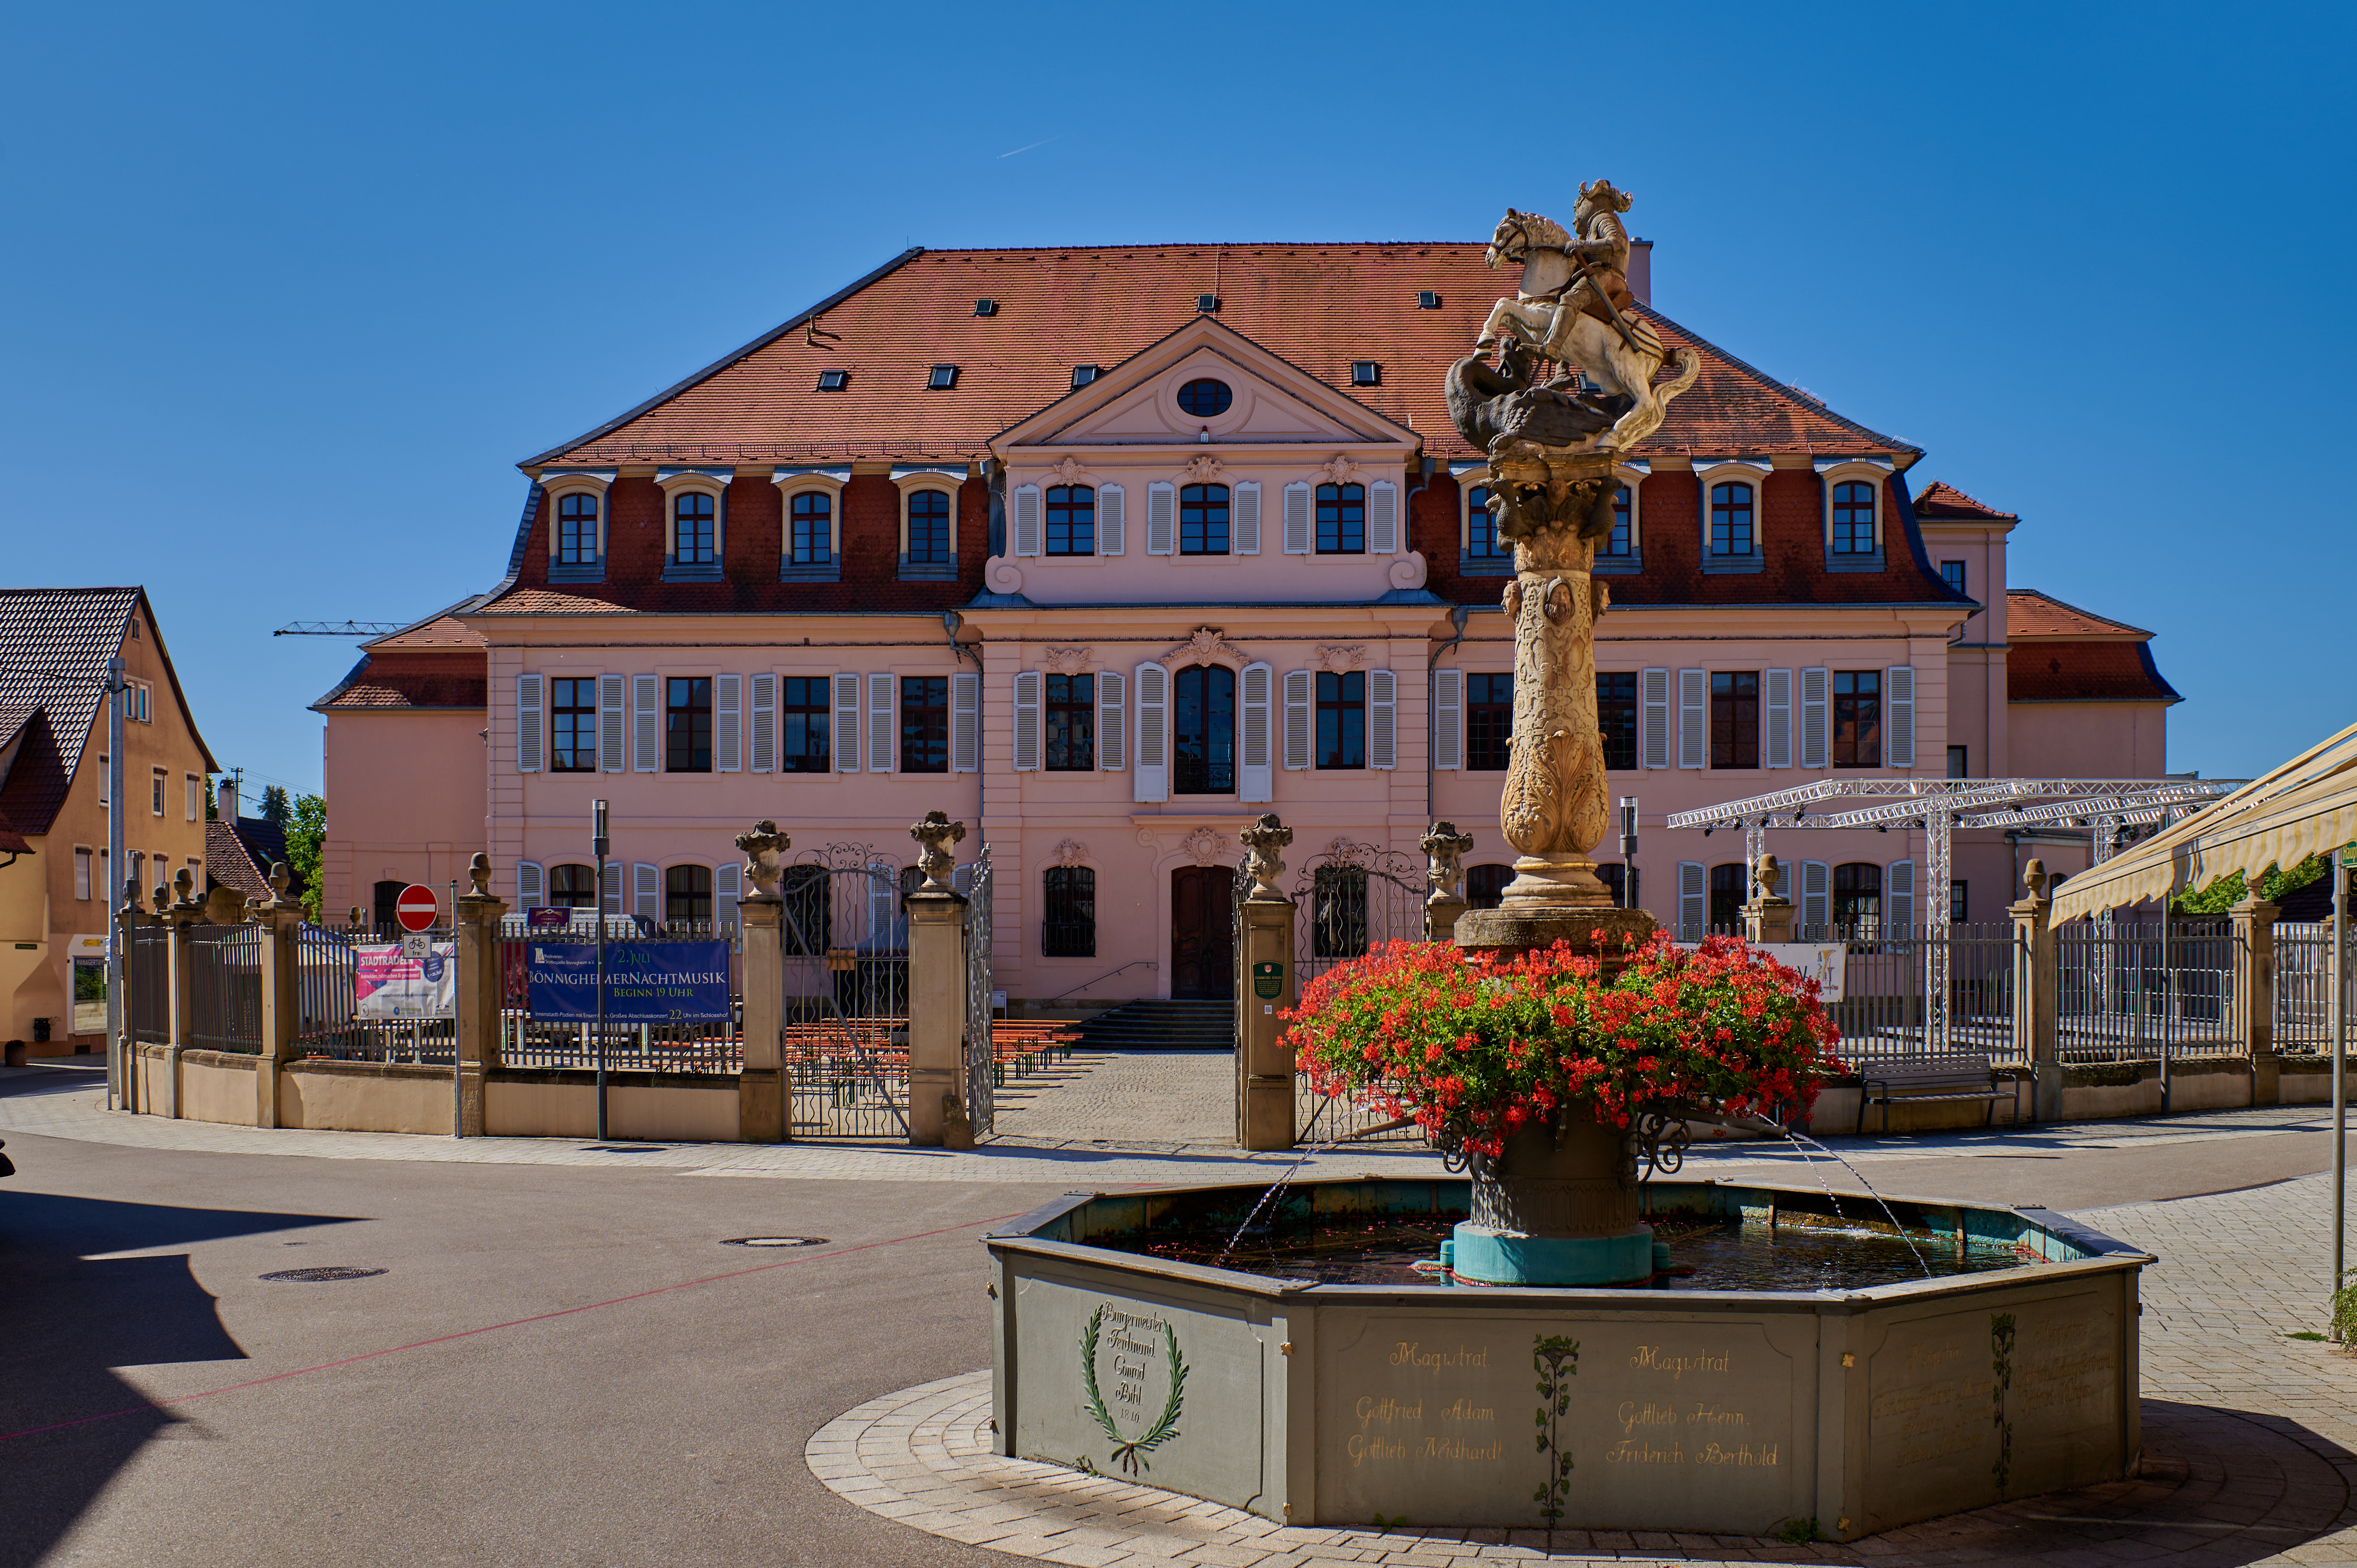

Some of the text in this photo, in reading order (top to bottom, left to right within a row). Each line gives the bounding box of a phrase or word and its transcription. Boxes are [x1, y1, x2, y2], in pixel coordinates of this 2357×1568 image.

[2343, 845, 2357, 862] Haup
[361, 955, 413, 966] STADTRADELN
[618, 950, 650, 966] 2. JULI
[614, 988, 694, 997] BEGINN 19 UHR
[669, 1010, 682, 1019] 22
[1356, 1396, 1422, 1428] Gottfried
[1619, 1401, 1677, 1433] Gottlieb
[1348, 1434, 1406, 1467] Gottlieb
[1606, 1437, 1685, 1464] Friderich
